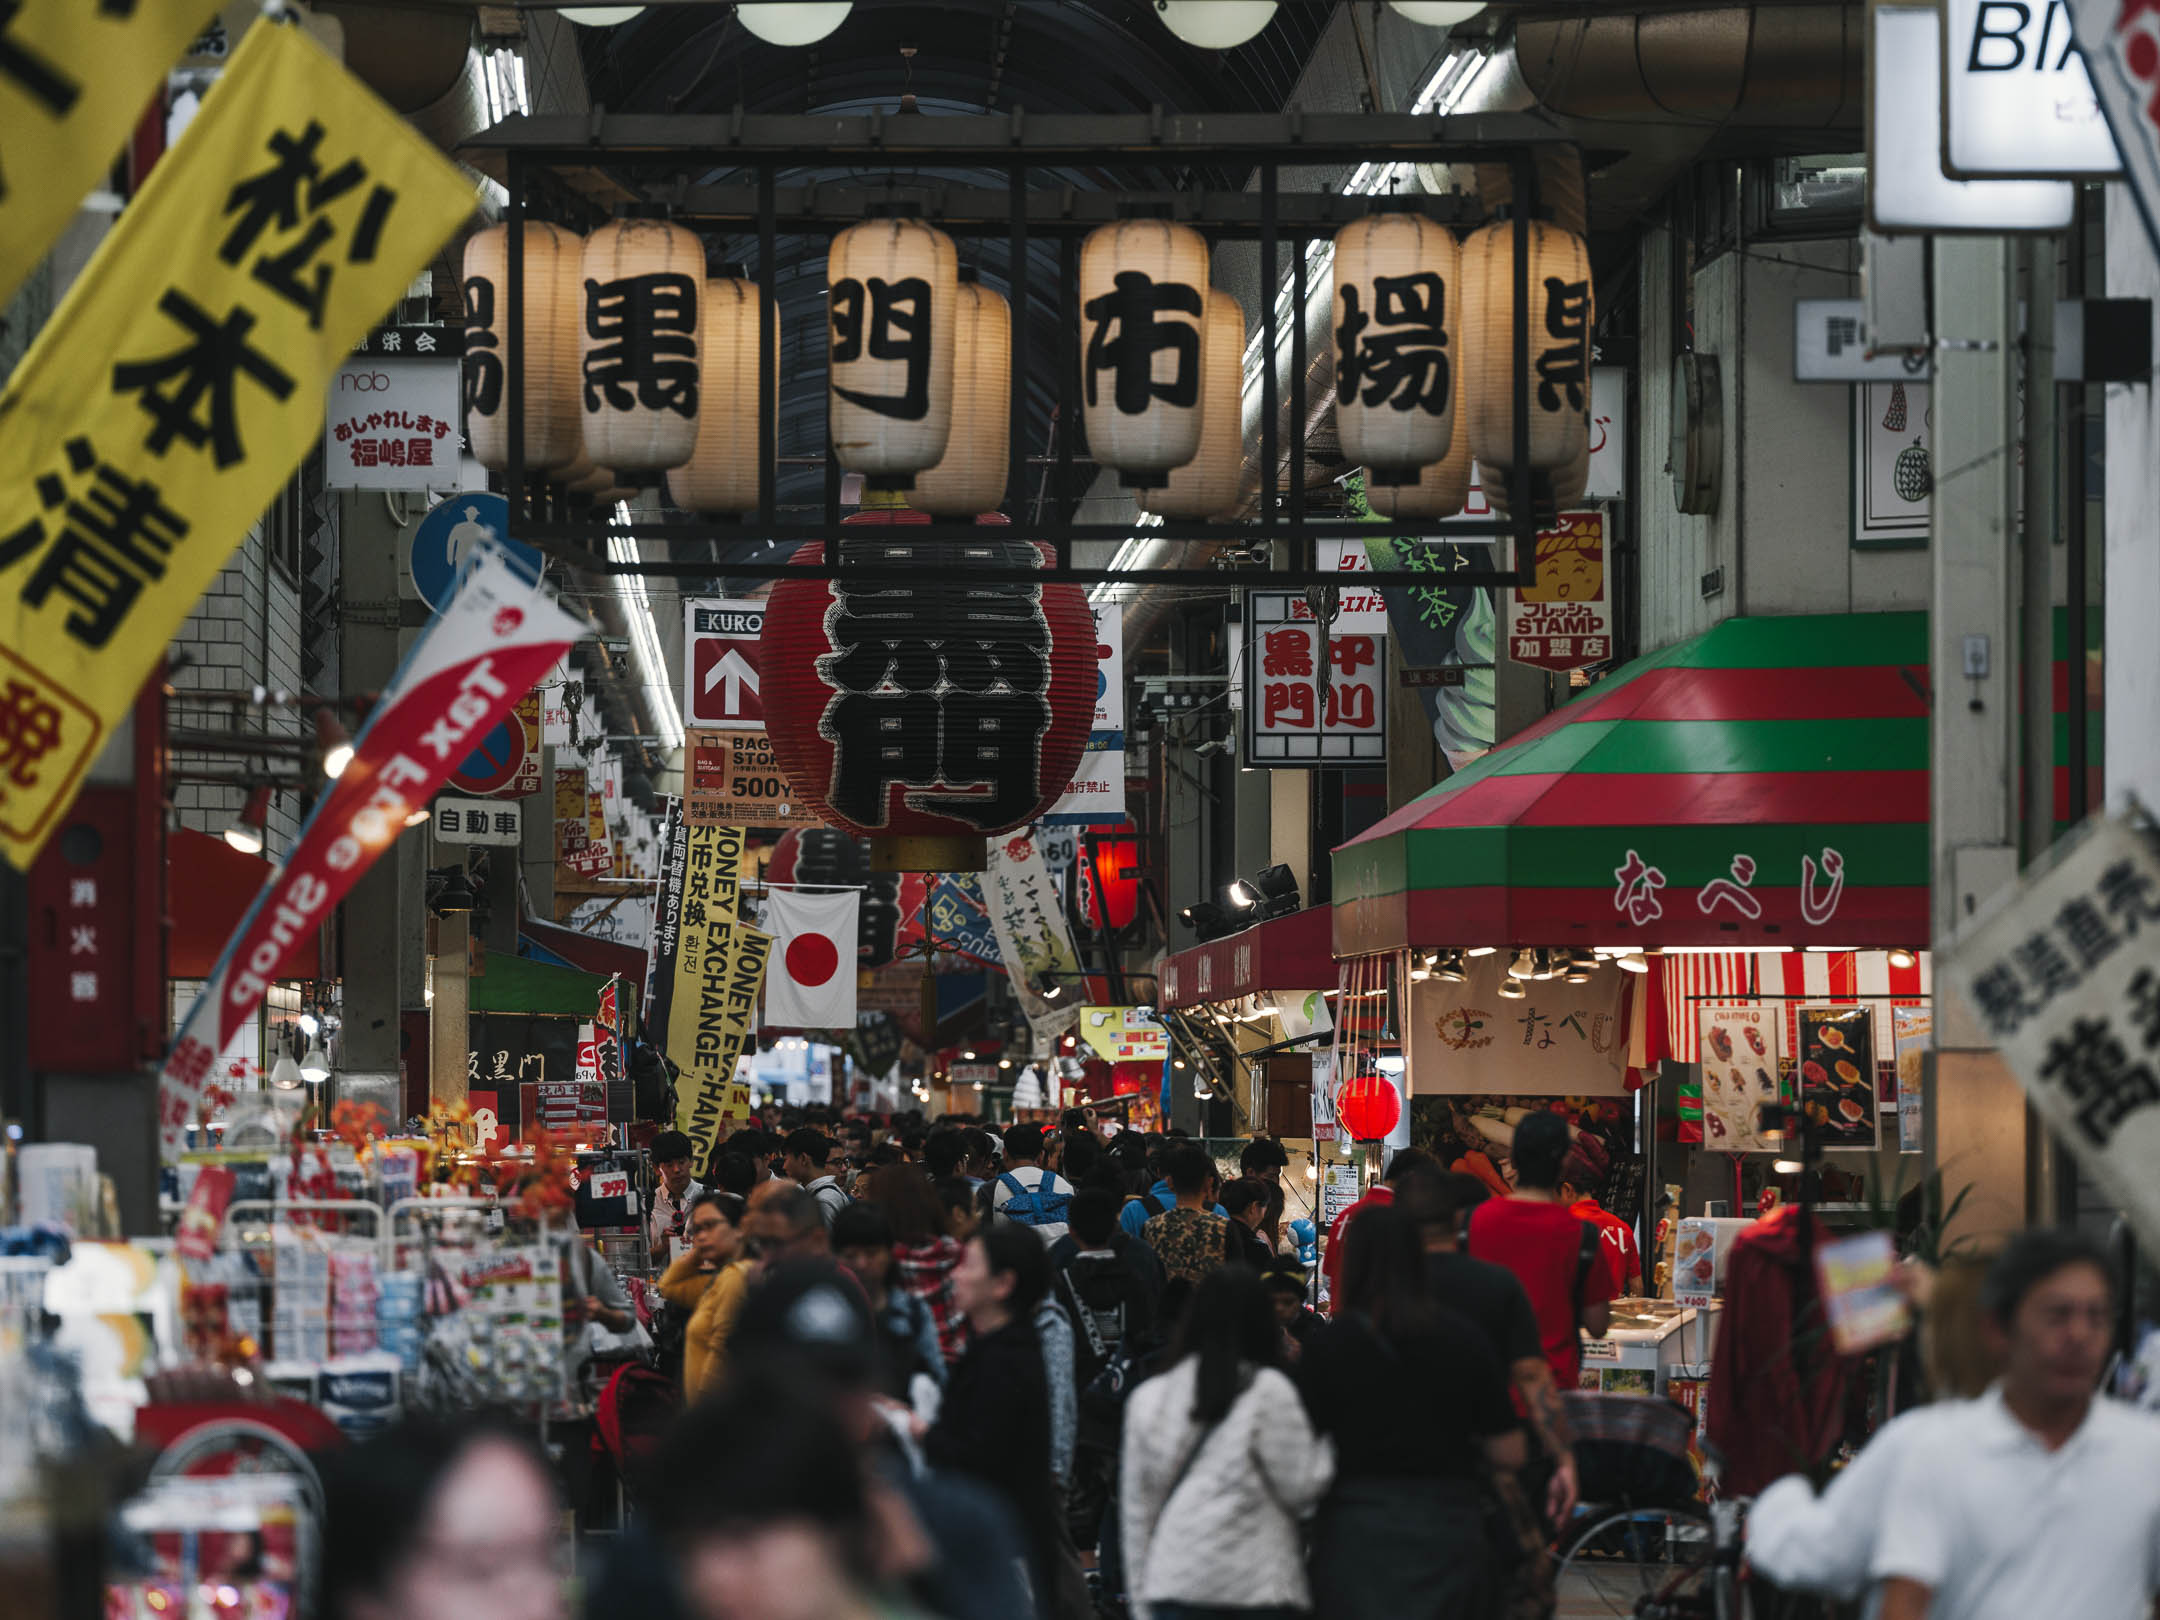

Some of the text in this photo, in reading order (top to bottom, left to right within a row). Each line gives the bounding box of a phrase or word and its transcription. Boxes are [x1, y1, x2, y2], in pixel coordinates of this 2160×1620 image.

[584, 270, 1449, 422] 黒 門 市 場
[341, 370, 391, 392] nob
[333, 410, 452, 442] おしゃれします
[350, 438, 433, 467] 福嶋屋
[1523, 602, 1594, 617] フレッシュ
[1516, 616, 1604, 635] STAMP
[1517, 638, 1605, 657] 加盟店
[1263, 629, 1315, 729] 黒門
[439, 808, 519, 836] 自動車
[1613, 847, 1845, 927] なべじ
[683, 934, 701, 974] 환전
[694, 920, 732, 1070] EXCHANGE
[727, 933, 765, 1029] MONEY
[600, 1178, 628, 1197] 399
